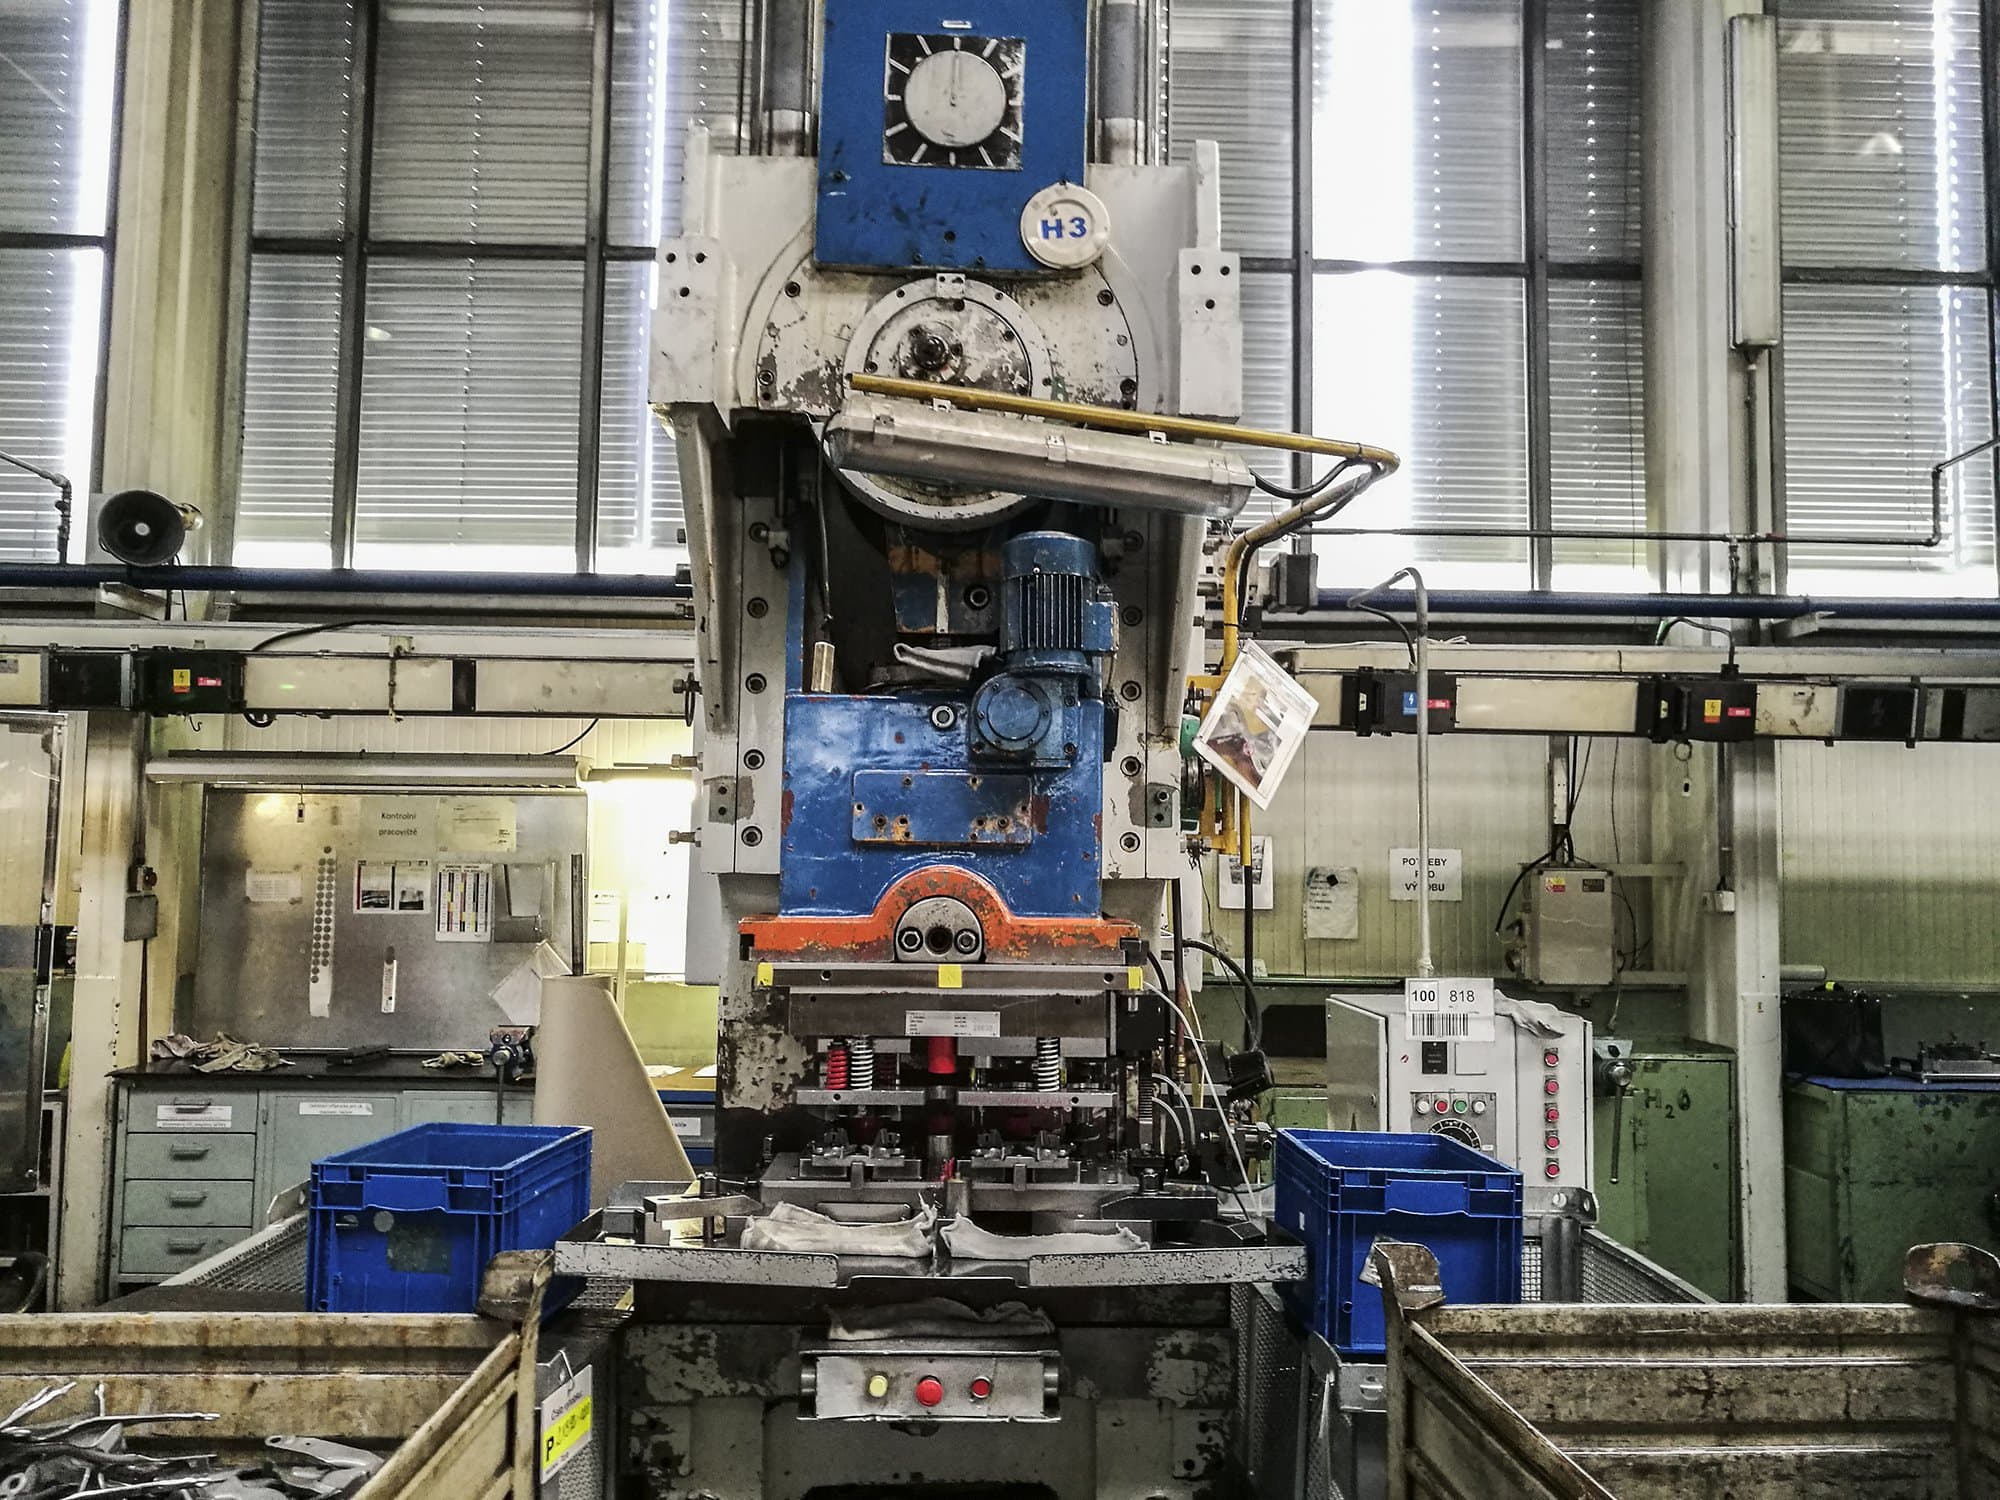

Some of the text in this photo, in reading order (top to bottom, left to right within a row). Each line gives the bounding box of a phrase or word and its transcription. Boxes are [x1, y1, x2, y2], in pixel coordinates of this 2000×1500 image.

[1040, 216, 1087, 240] H3
[1402, 858, 1447, 866] POEBY
[1412, 990, 1475, 1002] 100 818
